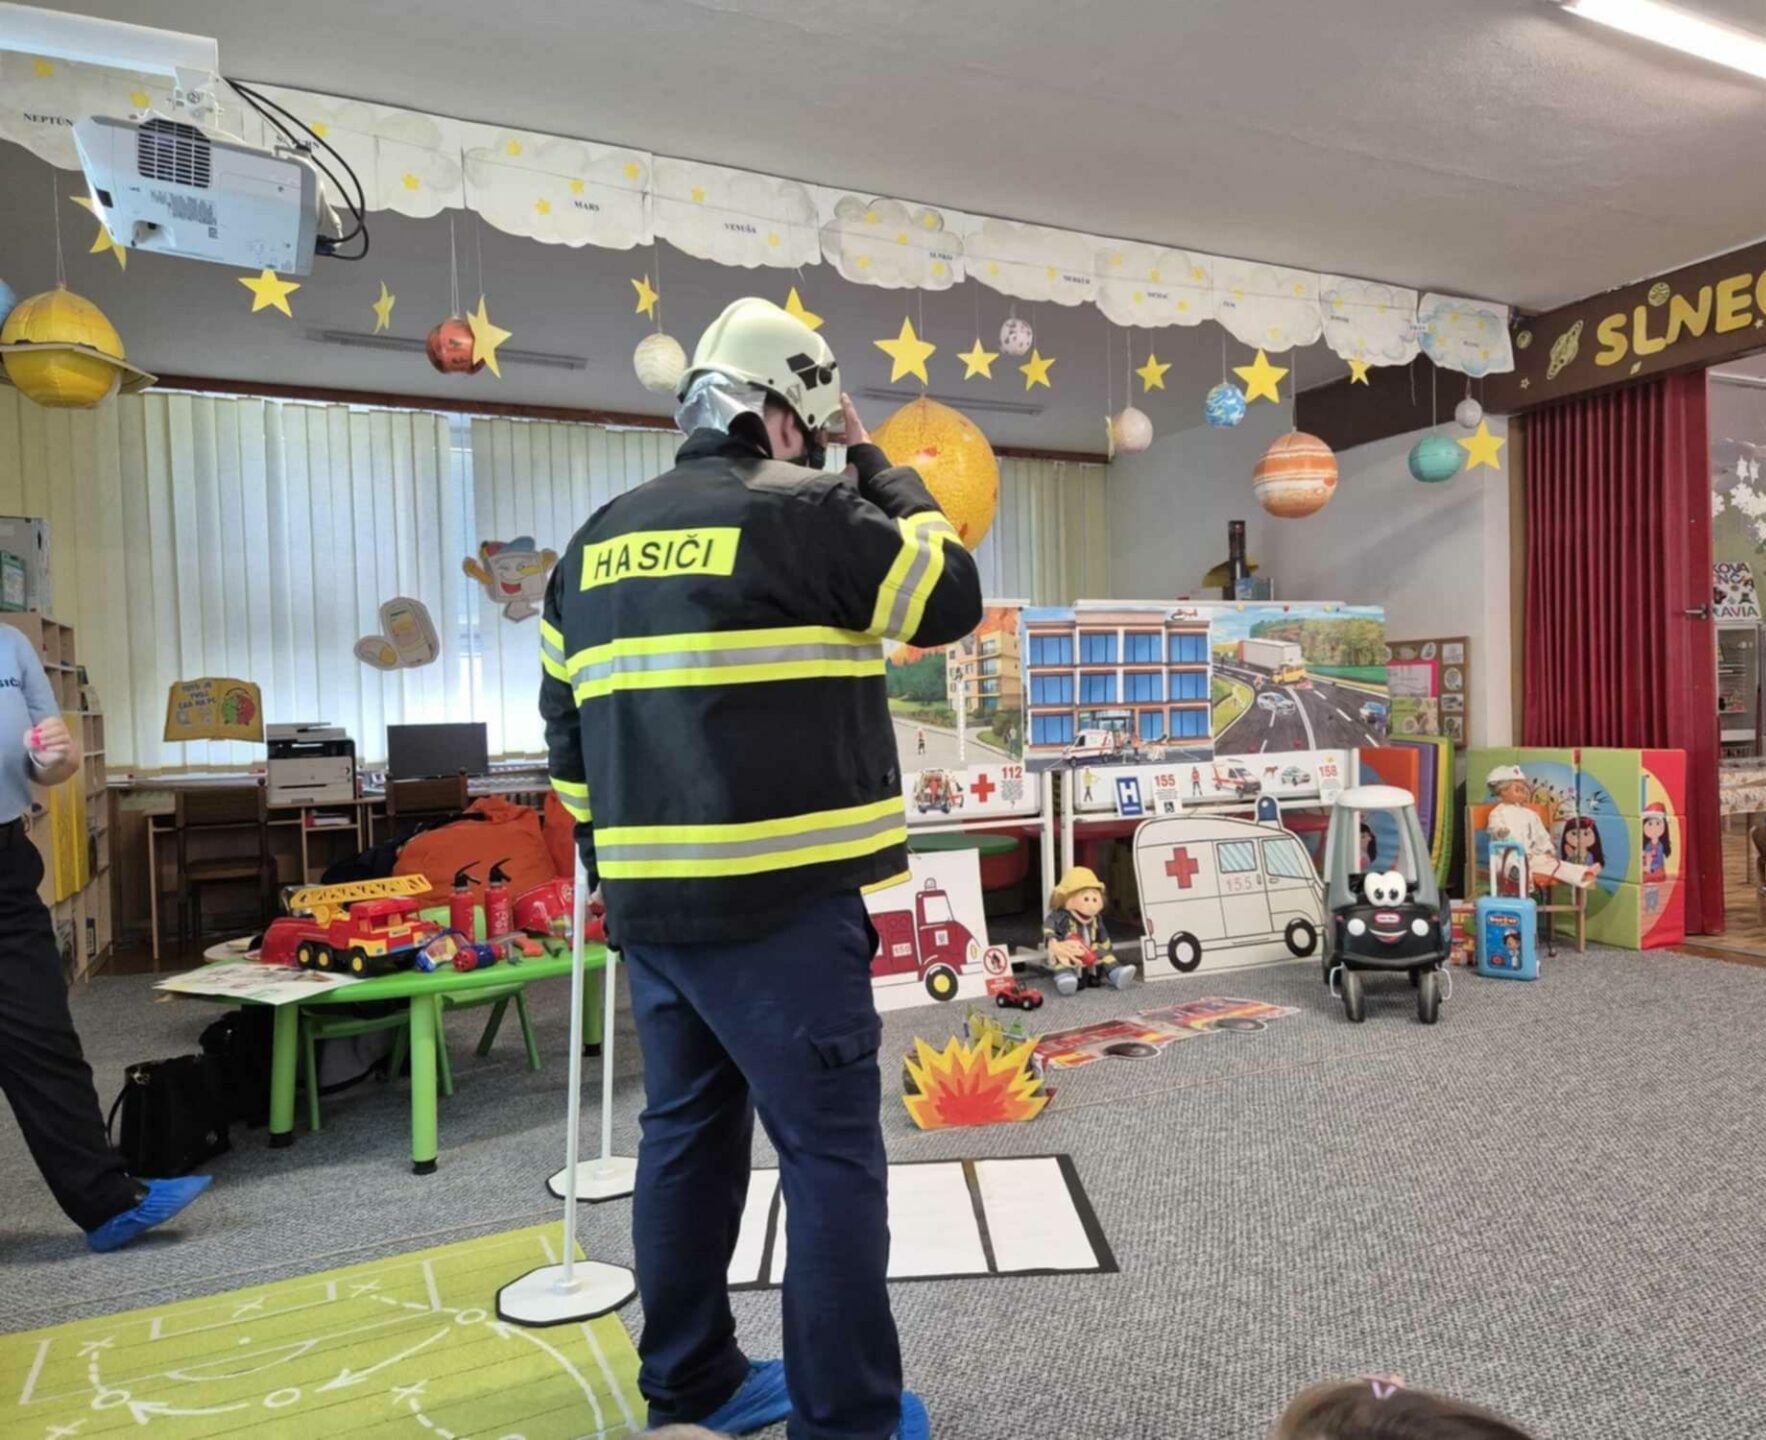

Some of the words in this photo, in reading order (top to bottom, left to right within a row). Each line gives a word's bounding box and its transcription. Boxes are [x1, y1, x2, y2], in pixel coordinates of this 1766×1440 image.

[574, 200, 600, 211] MARS
[594, 533, 714, 580] HASIČI
[1001, 766, 1023, 779] 112
[1154, 773, 1176, 787] 155
[1119, 781, 1139, 804] H
[1226, 876, 1252, 892] 155
